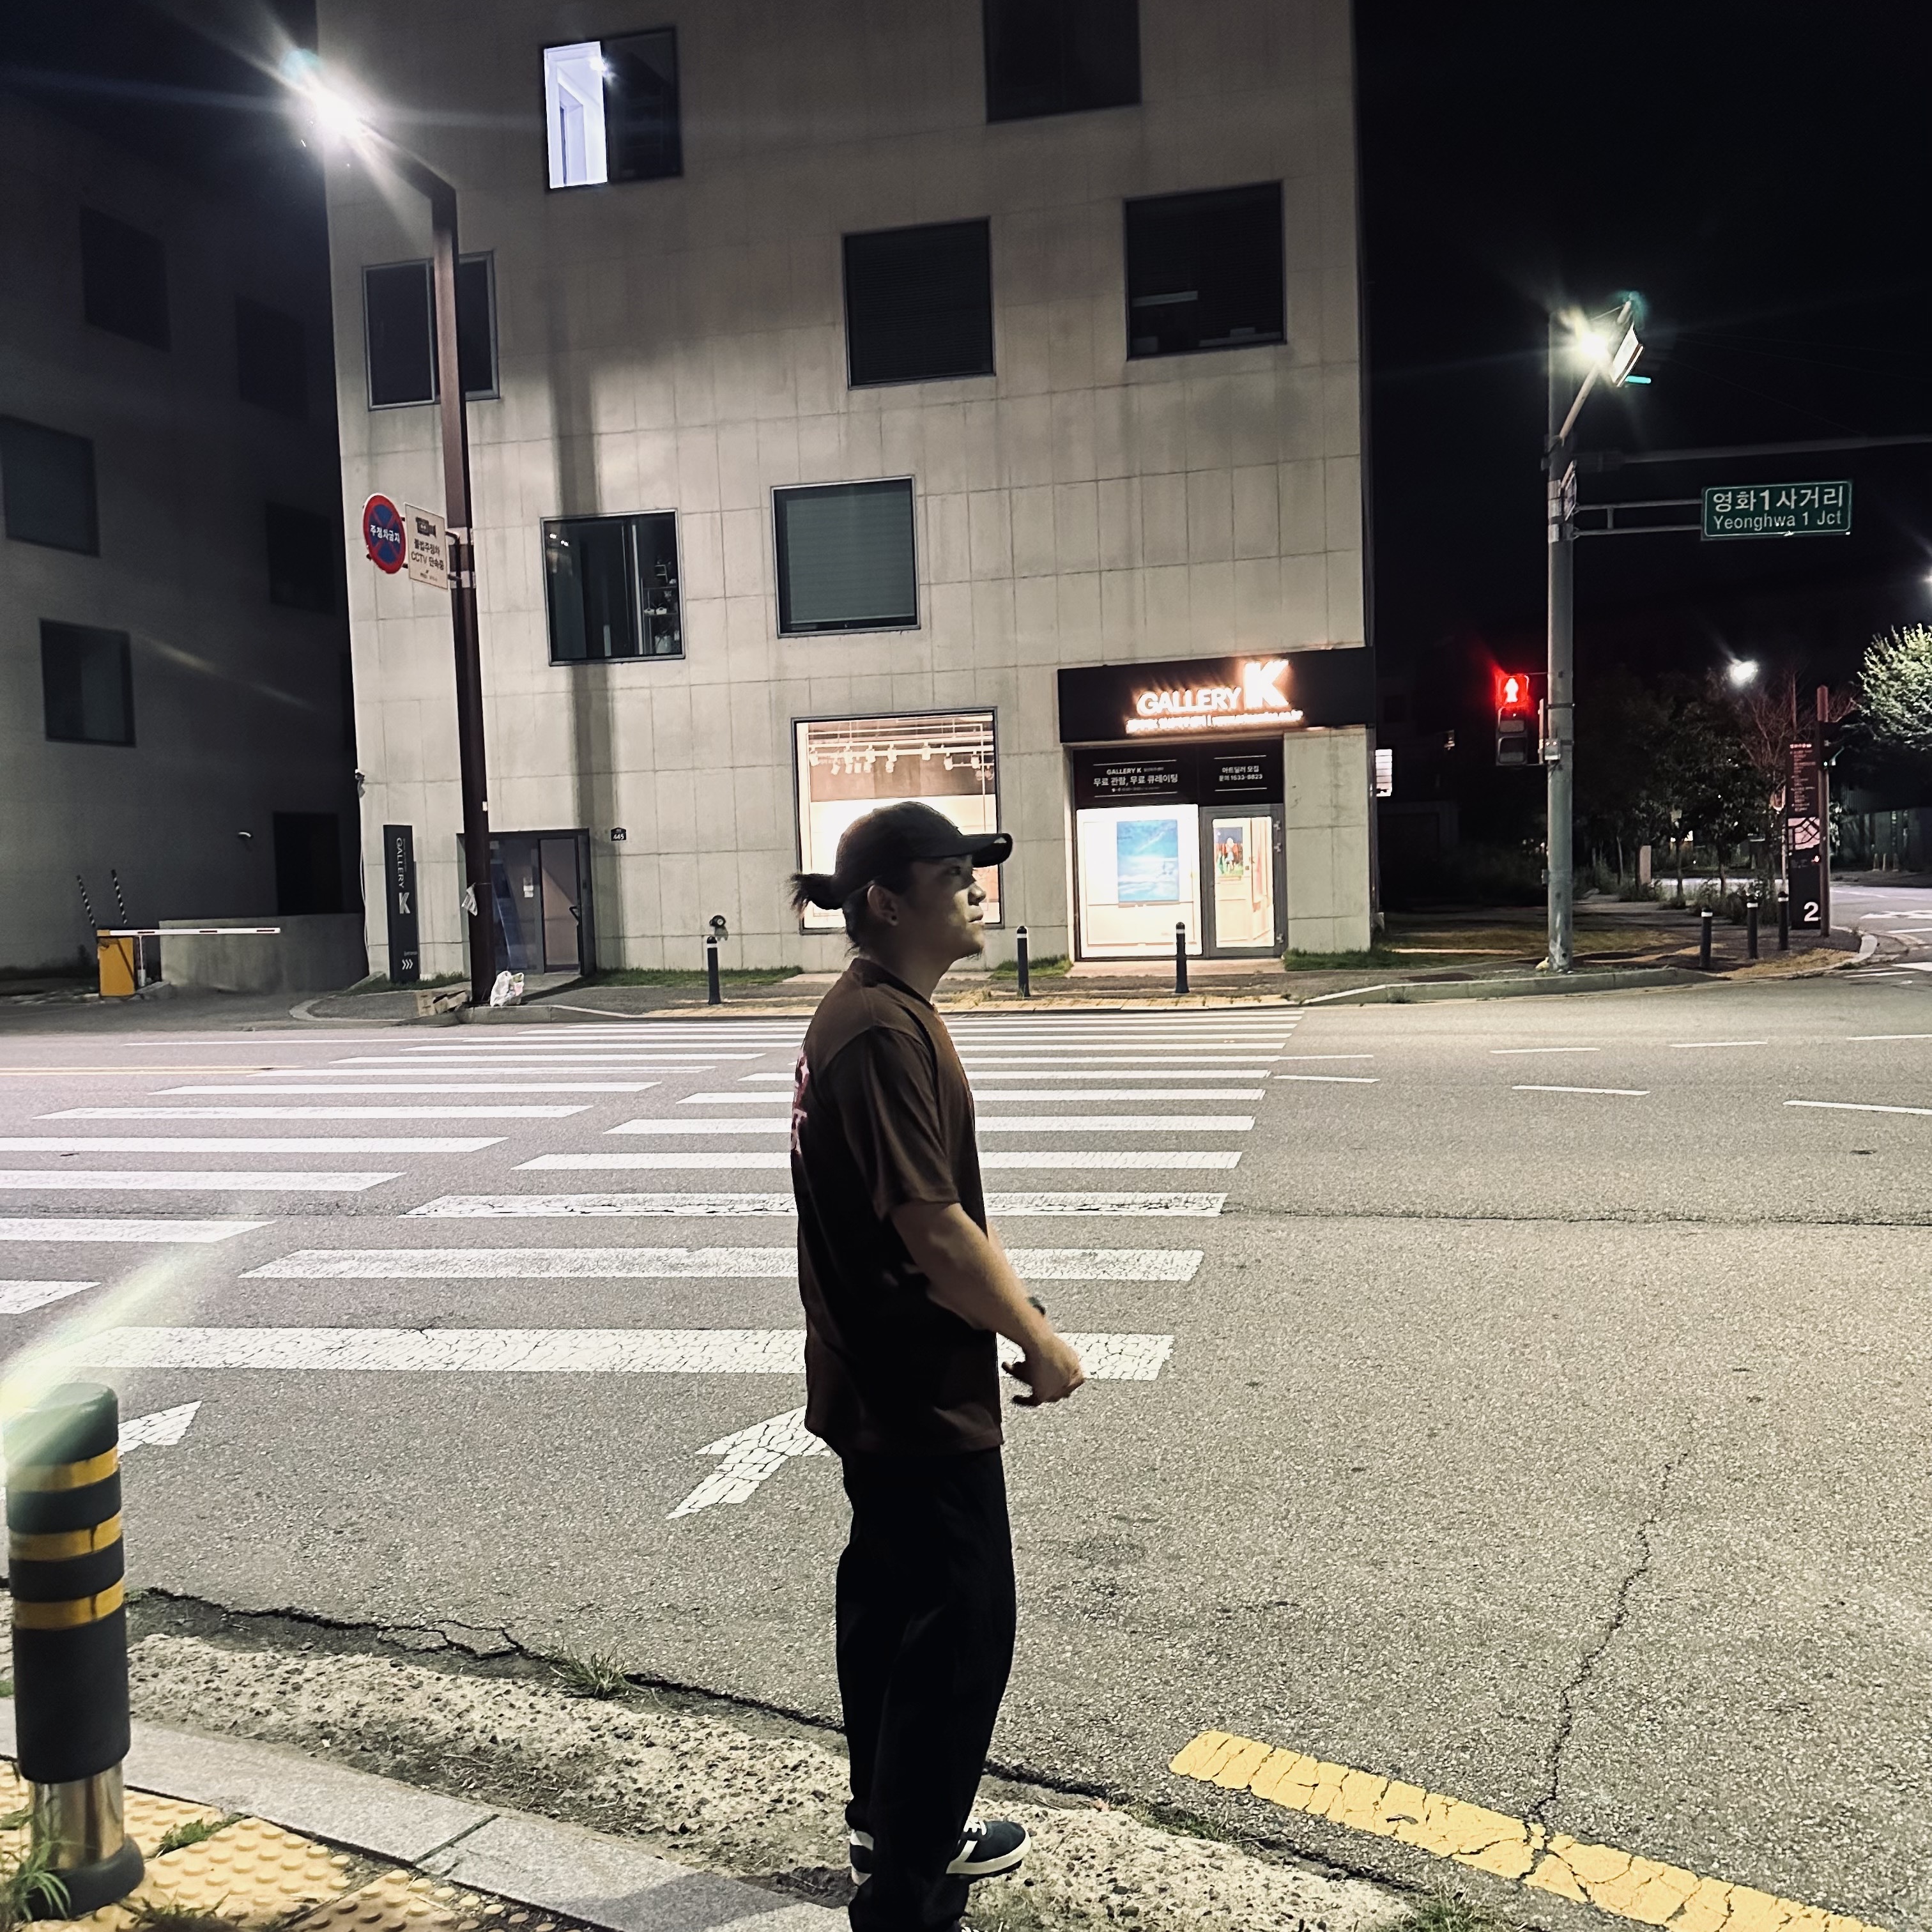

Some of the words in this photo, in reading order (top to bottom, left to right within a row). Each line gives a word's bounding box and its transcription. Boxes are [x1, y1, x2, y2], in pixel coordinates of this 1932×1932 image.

[1713, 513, 1796, 531] Yeonghwa
[1802, 512, 1809, 526] 1
[1817, 510, 1841, 525] Jct
[370, 525, 401, 544] 주정차금지
[411, 551, 427, 565] CCTV
[1137, 687, 1242, 716] GALLERY
[1245, 659, 1289, 708] K
[1093, 778, 1109, 786] 무료
[1130, 776, 1146, 785] 무료
[396, 838, 404, 889] GALLERY
[399, 892, 411, 914] K
[1804, 901, 1819, 922] 2
